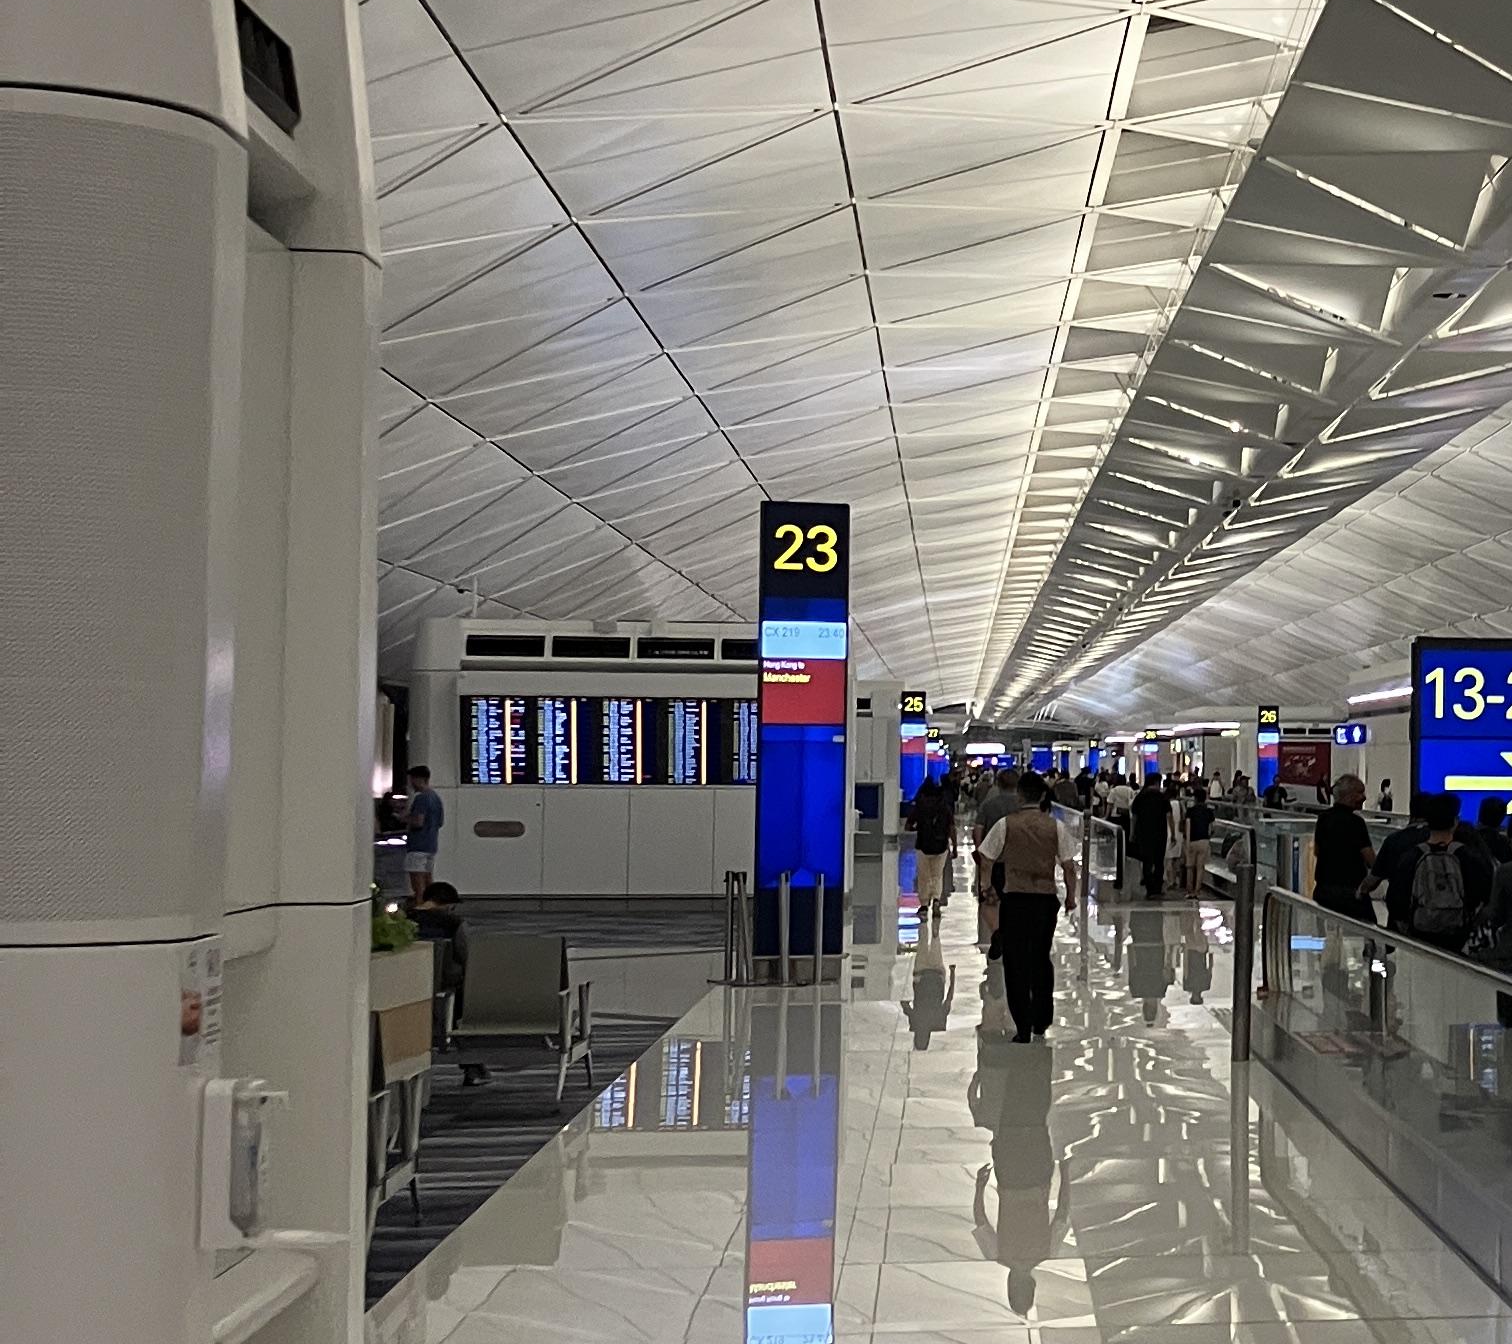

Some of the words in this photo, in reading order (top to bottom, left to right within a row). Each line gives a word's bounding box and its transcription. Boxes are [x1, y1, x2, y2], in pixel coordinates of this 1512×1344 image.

[774, 524, 838, 573] 23
[904, 697, 924, 712] 25
[1260, 710, 1277, 723] 26
